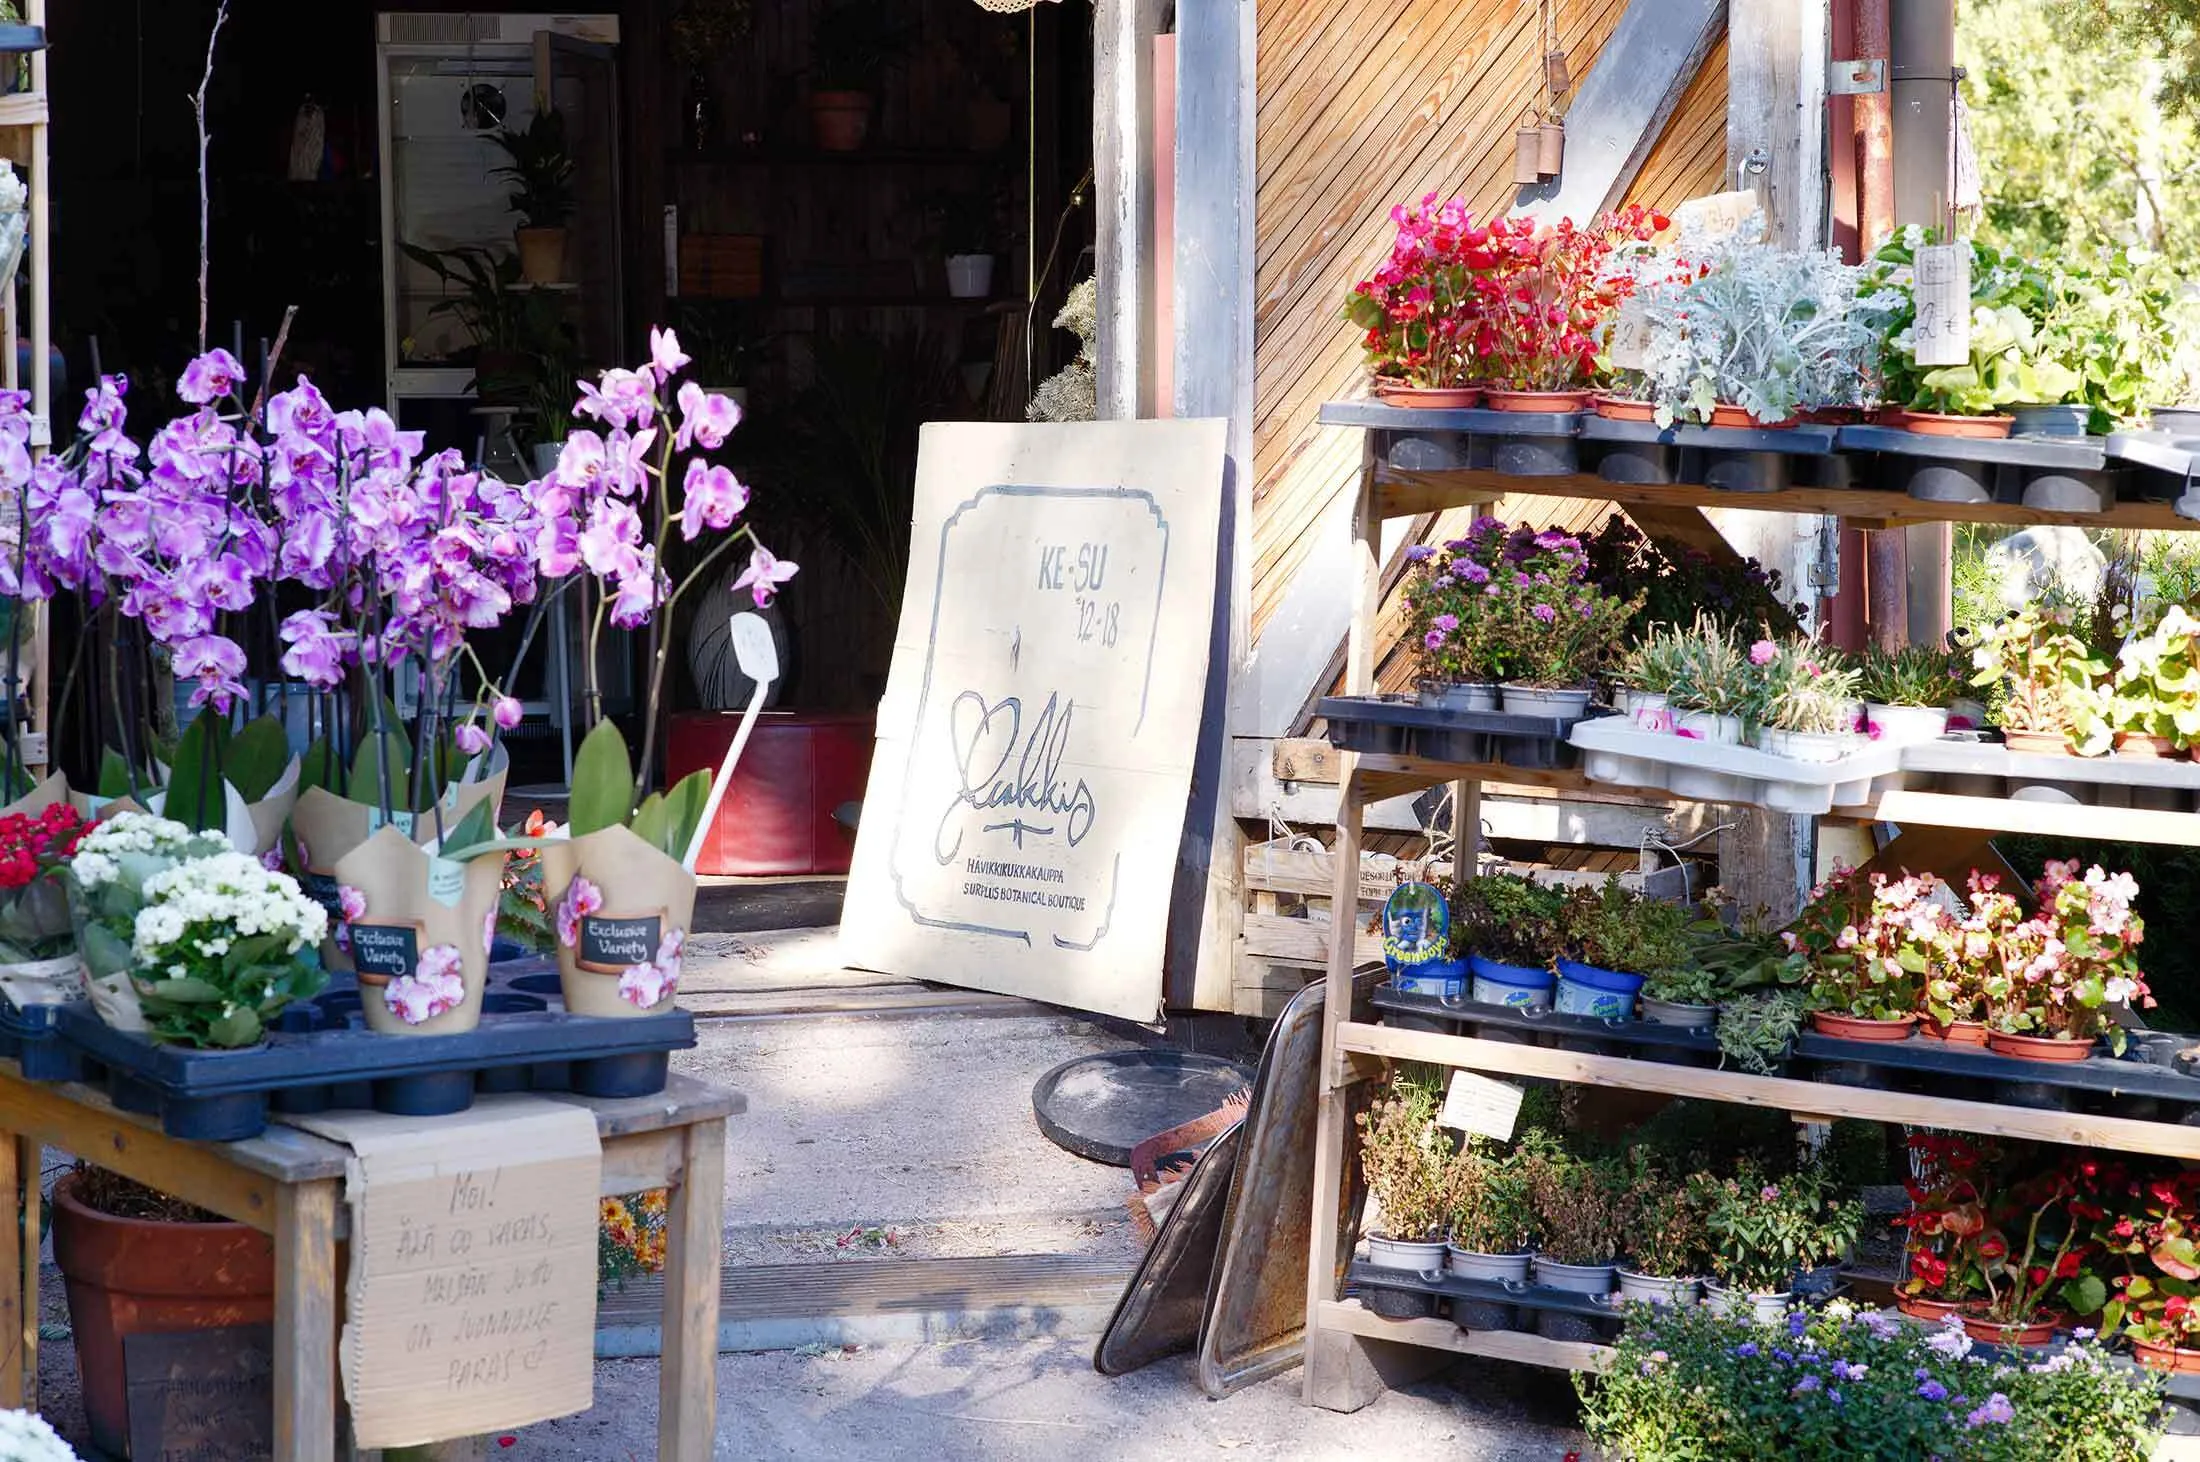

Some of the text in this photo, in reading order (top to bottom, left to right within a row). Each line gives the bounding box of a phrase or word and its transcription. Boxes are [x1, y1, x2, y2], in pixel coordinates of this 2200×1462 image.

[1917, 302, 1937, 340] 2
[963, 882, 1087, 912] SURPLUS BOTANICAL BOUTIQUE
[354, 929, 405, 947] Exclusive
[588, 920, 648, 938] Exclusive
[363, 947, 407, 975] Variety
[599, 939, 648, 963] Variety
[447, 1347, 515, 1392] PARAS
